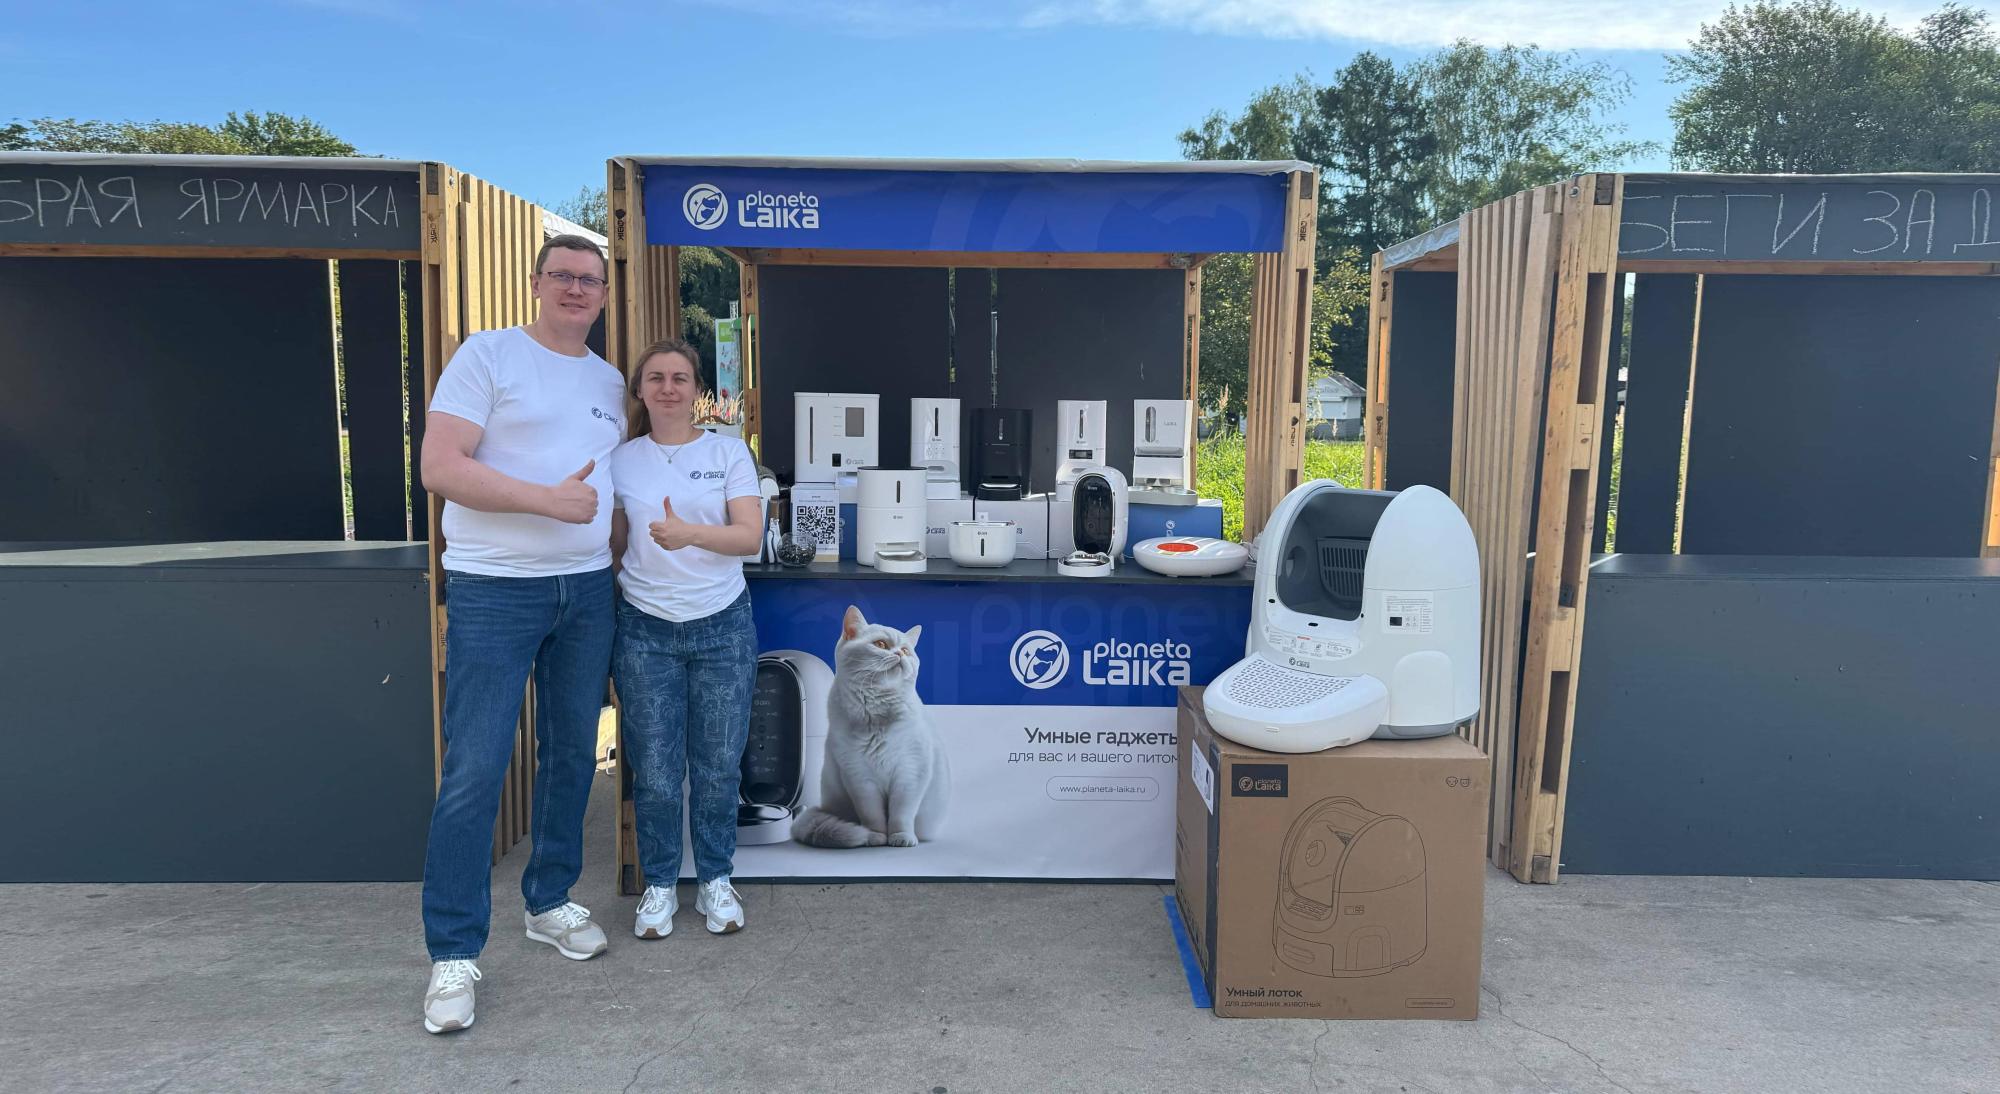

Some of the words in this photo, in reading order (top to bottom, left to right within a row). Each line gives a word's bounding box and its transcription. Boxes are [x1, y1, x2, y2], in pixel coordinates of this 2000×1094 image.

[178, 178, 399, 228] ЯРМАРКА
[746, 190, 819, 211] planeta
[1618, 191, 1828, 255] БЕГИ
[1852, 188, 1936, 254] ЗА
[1093, 637, 1191, 664] planeta
[1024, 727, 1091, 744] Умные
[1008, 752, 1034, 763] для
[1038, 752, 1063, 762] вас
[1067, 752, 1076, 762] и
[1080, 752, 1133, 764] вашего
[1059, 784, 1146, 794] www.planeta-laika.ru
[1225, 986, 1265, 998] Умный
[1267, 988, 1303, 998] лоток
